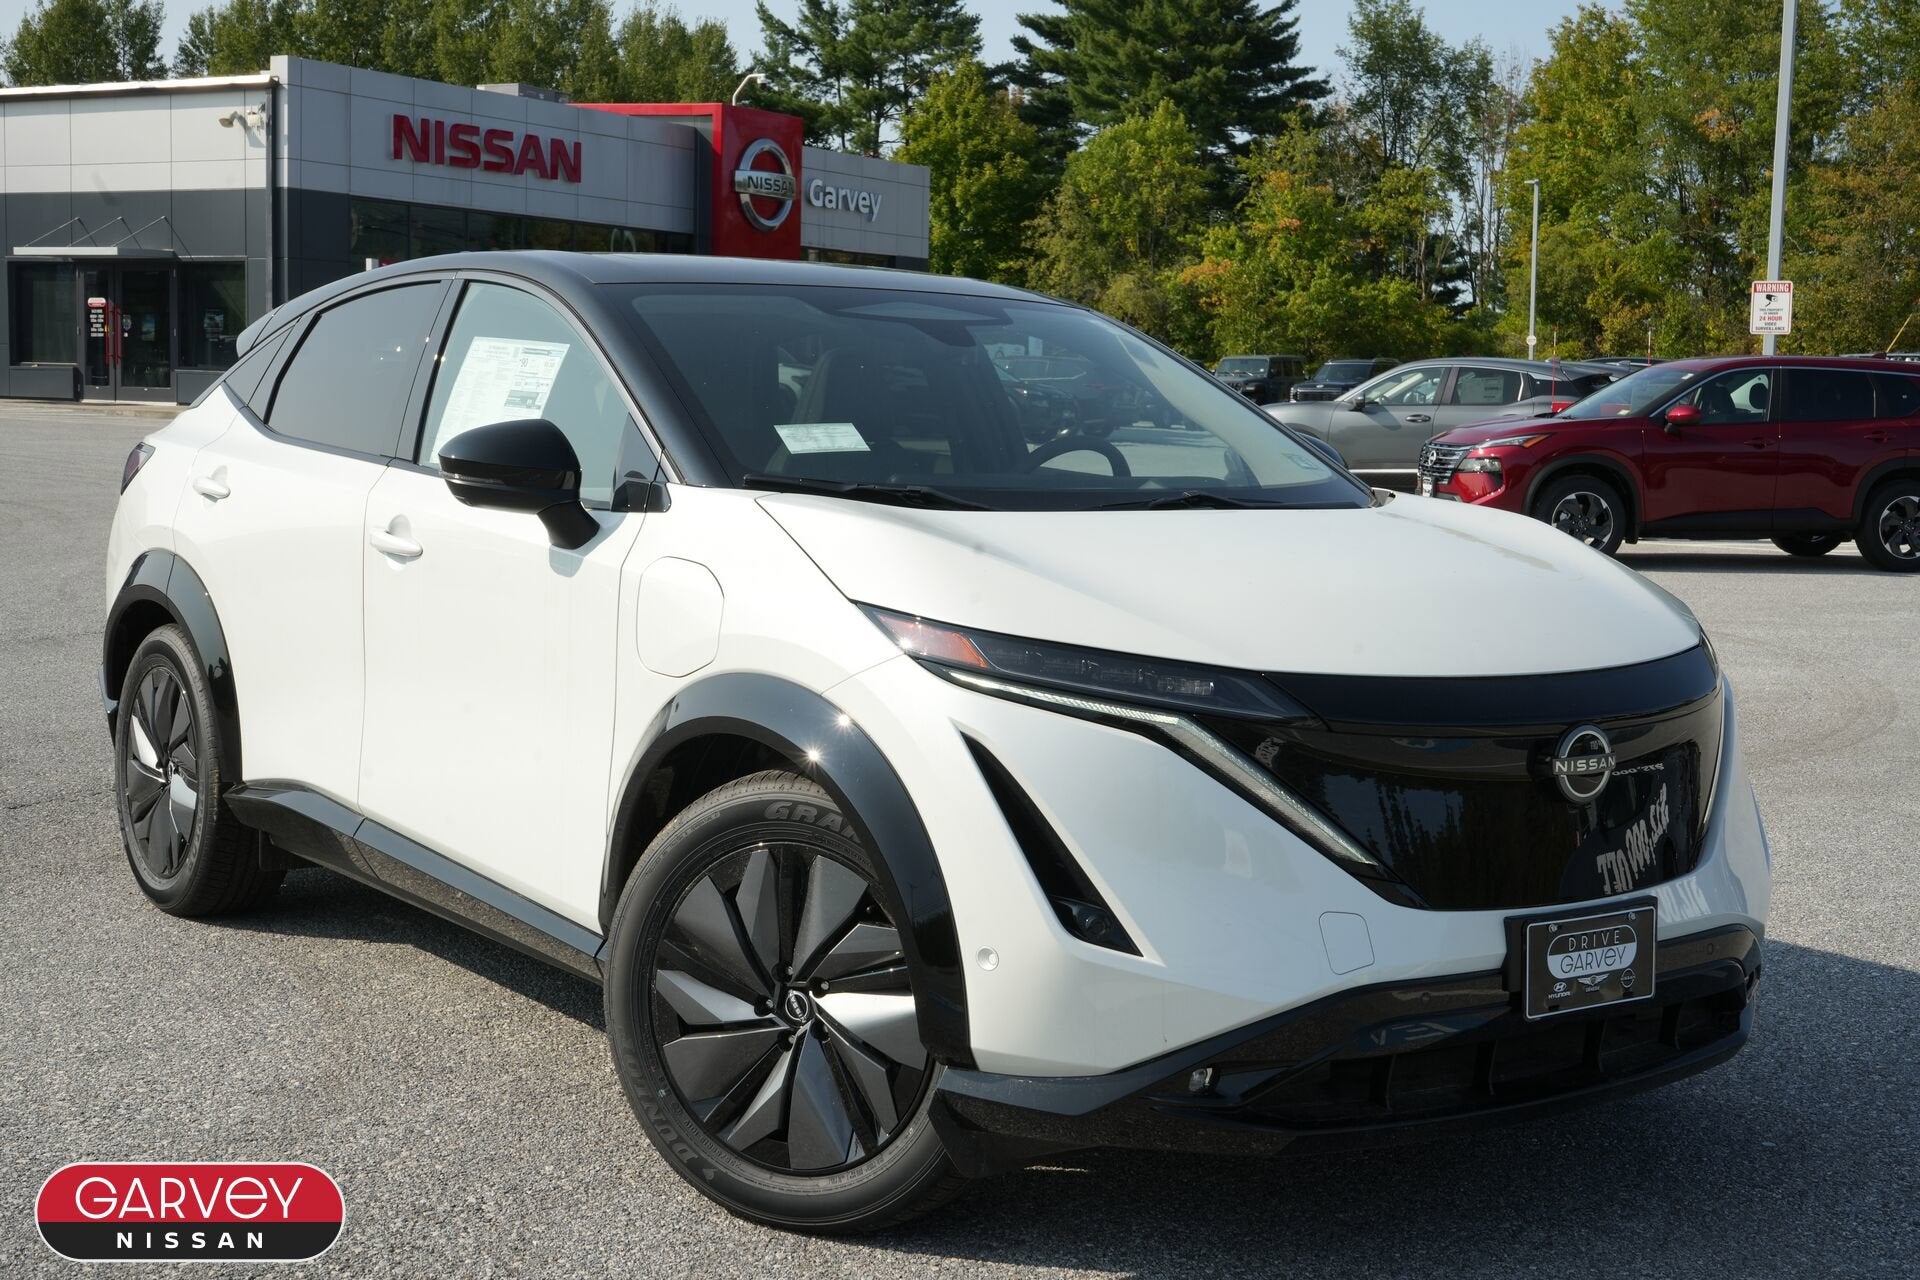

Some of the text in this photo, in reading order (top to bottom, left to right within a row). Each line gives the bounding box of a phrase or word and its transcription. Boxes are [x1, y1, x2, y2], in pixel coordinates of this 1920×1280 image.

[392, 114, 582, 183] NISSAN
[747, 174, 795, 195] NISSAN
[807, 177, 883, 223] Garvey
[1756, 283, 1789, 292] WARNING
[1555, 756, 1616, 773] NISSAN
[1568, 929, 1621, 951] DRIVE
